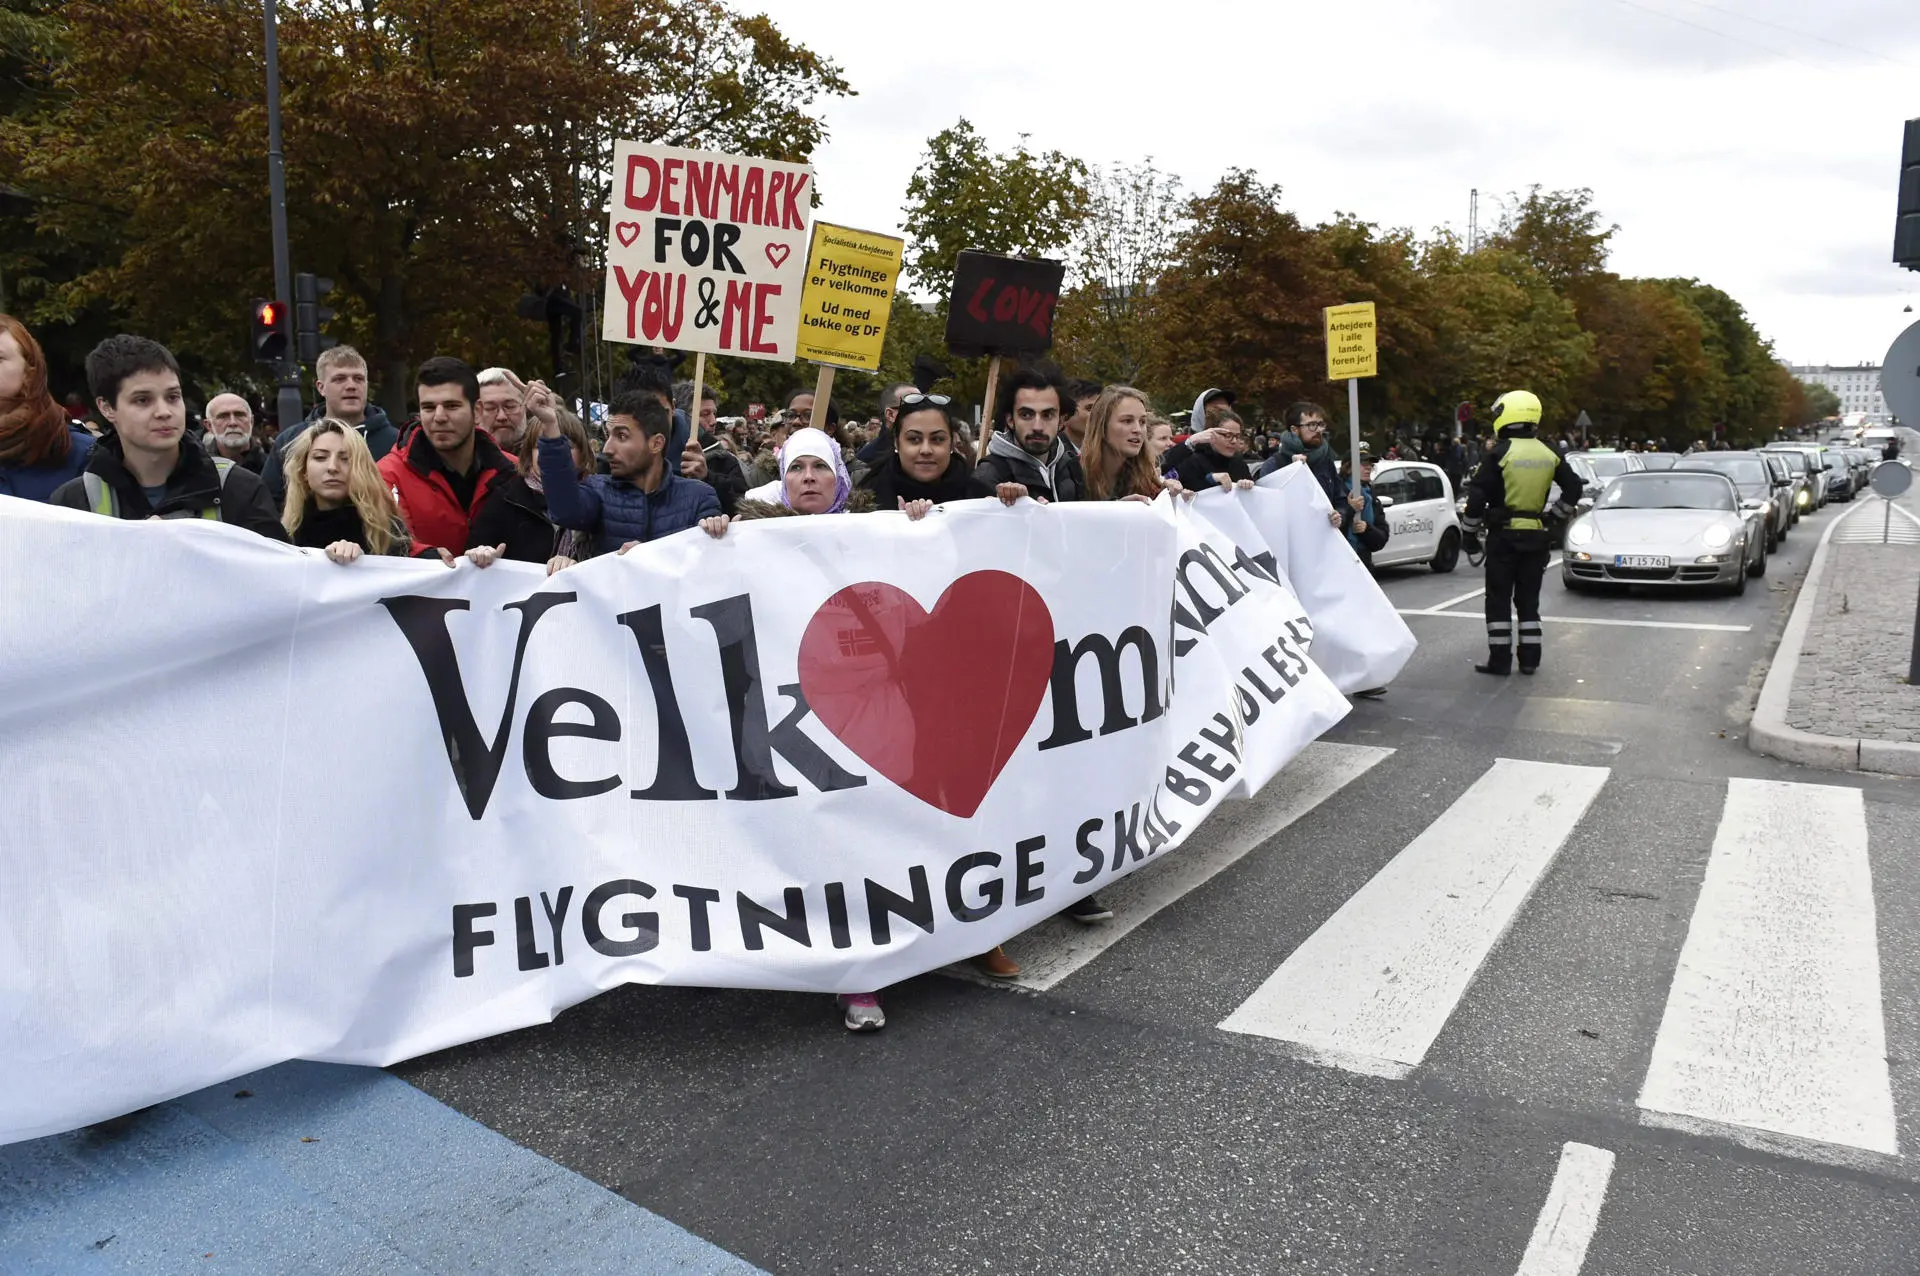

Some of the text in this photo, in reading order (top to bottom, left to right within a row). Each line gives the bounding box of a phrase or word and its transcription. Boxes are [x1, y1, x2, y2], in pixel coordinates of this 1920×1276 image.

[625, 154, 809, 230] DENMARK
[654, 217, 747, 274] FOR
[823, 235, 857, 249] Socialistisk
[820, 258, 887, 283] Flygtninge
[811, 275, 888, 298] er velkomne
[613, 265, 782, 354] YOU & ME
[821, 301, 871, 320] Ud med
[803, 313, 881, 337] Løkke og DF
[1330, 321, 1373, 331] Arbejdere
[1346, 333, 1362, 342] alle
[1338, 344, 1365, 353] lande,
[1332, 354, 1372, 366] foren jer!
[1622, 556, 1666, 567] AT 15 761
[452, 834, 1047, 978] FLYGTNINGE
[1072, 784, 1182, 885] SKAL
